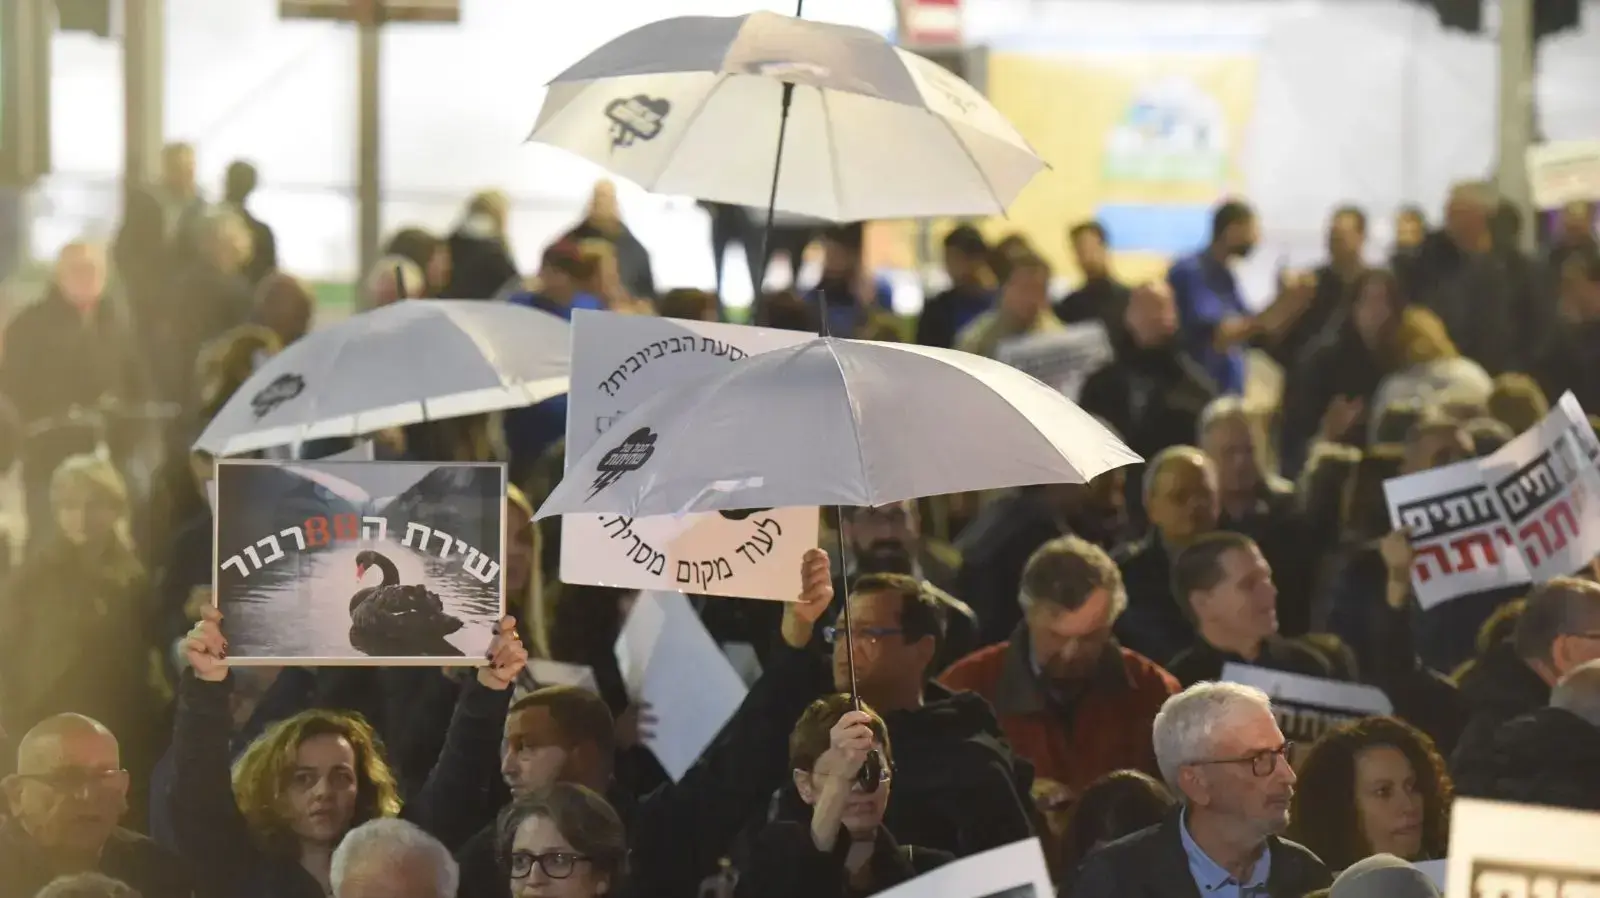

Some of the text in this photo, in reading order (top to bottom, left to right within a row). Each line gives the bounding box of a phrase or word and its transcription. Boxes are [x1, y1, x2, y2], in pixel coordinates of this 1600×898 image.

[701, 337, 749, 362] סעת
[1403, 489, 1493, 536] חתים
[401, 521, 500, 584] שירת
[735, 517, 782, 564] לעוד
[1413, 525, 1514, 583] יתה
[676, 556, 733, 591] מקום
